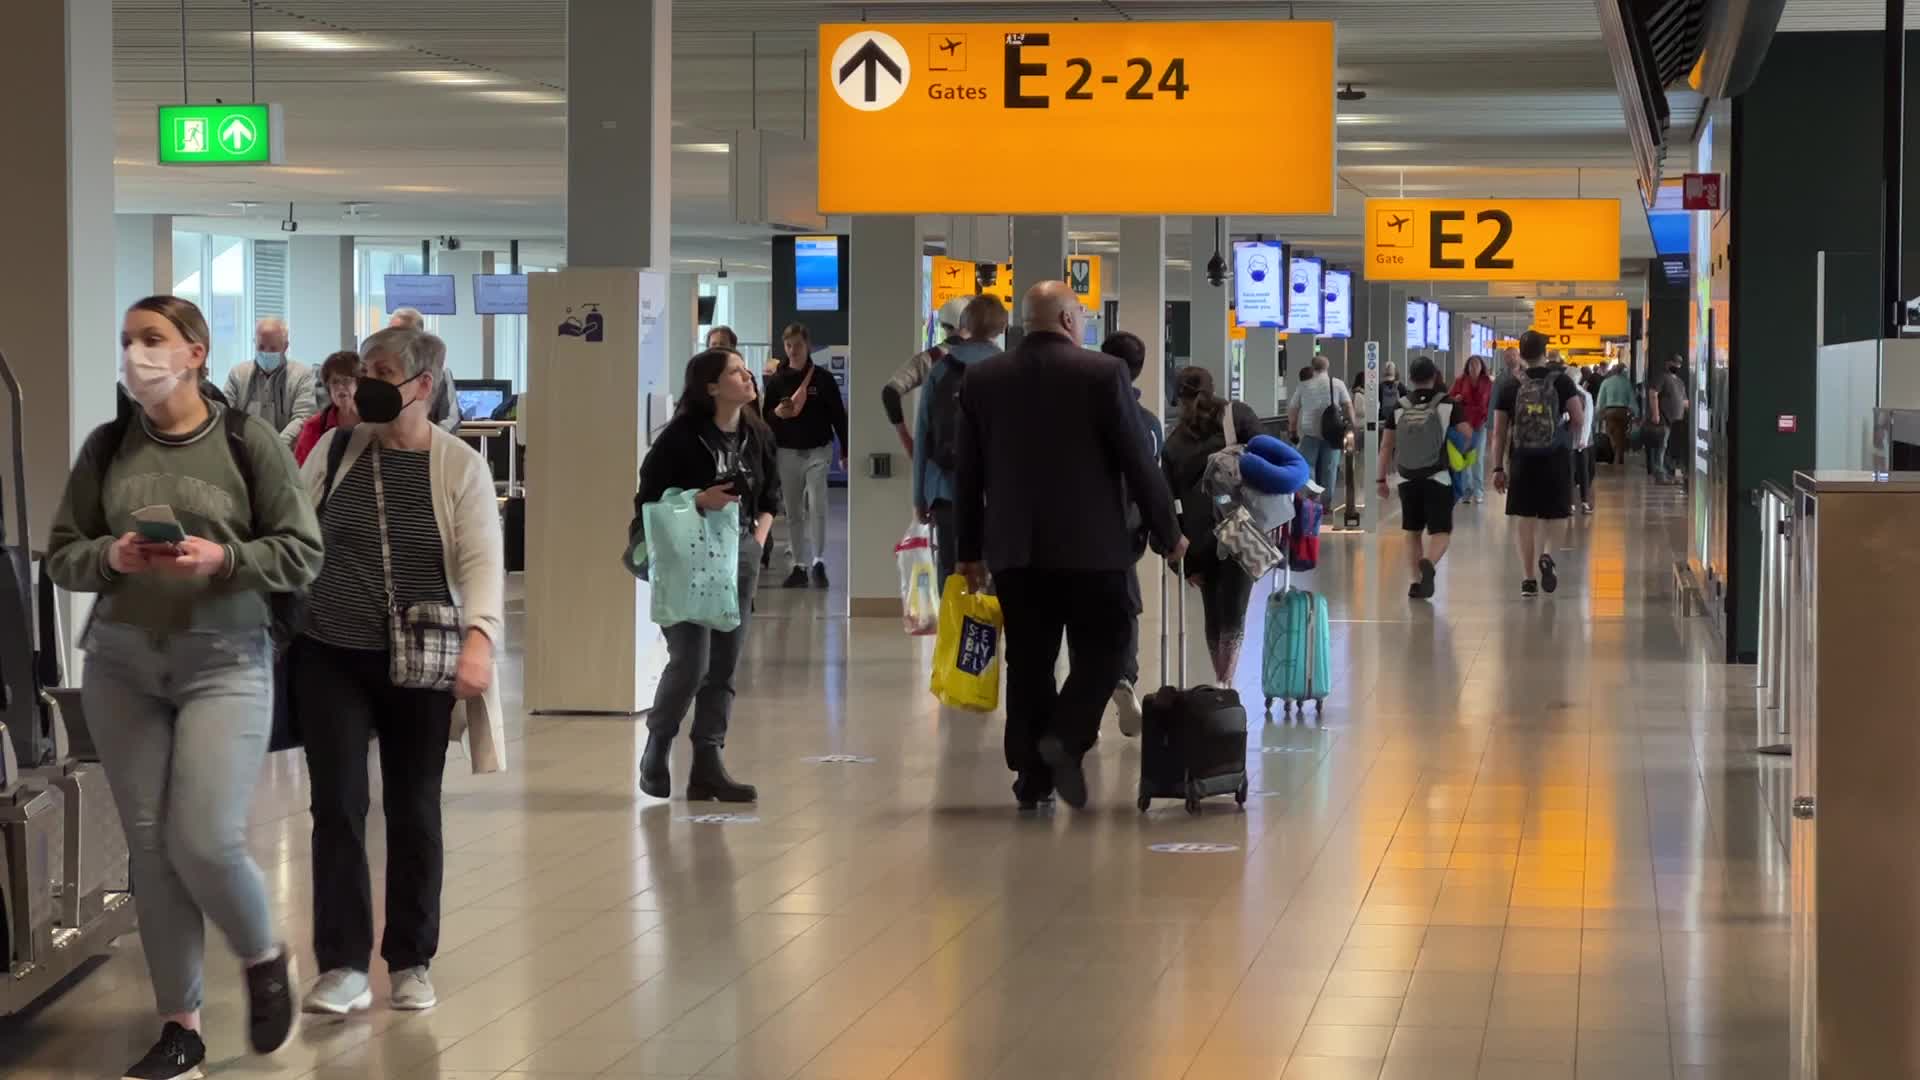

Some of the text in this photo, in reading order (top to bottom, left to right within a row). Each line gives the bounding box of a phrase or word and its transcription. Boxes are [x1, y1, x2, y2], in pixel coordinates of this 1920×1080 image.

[1004, 33, 1190, 108] E 2-24
[928, 83, 987, 101] Gates
[1430, 209, 1514, 269] E2
[1376, 254, 1404, 264] Gate
[1559, 305, 1596, 330] E4
